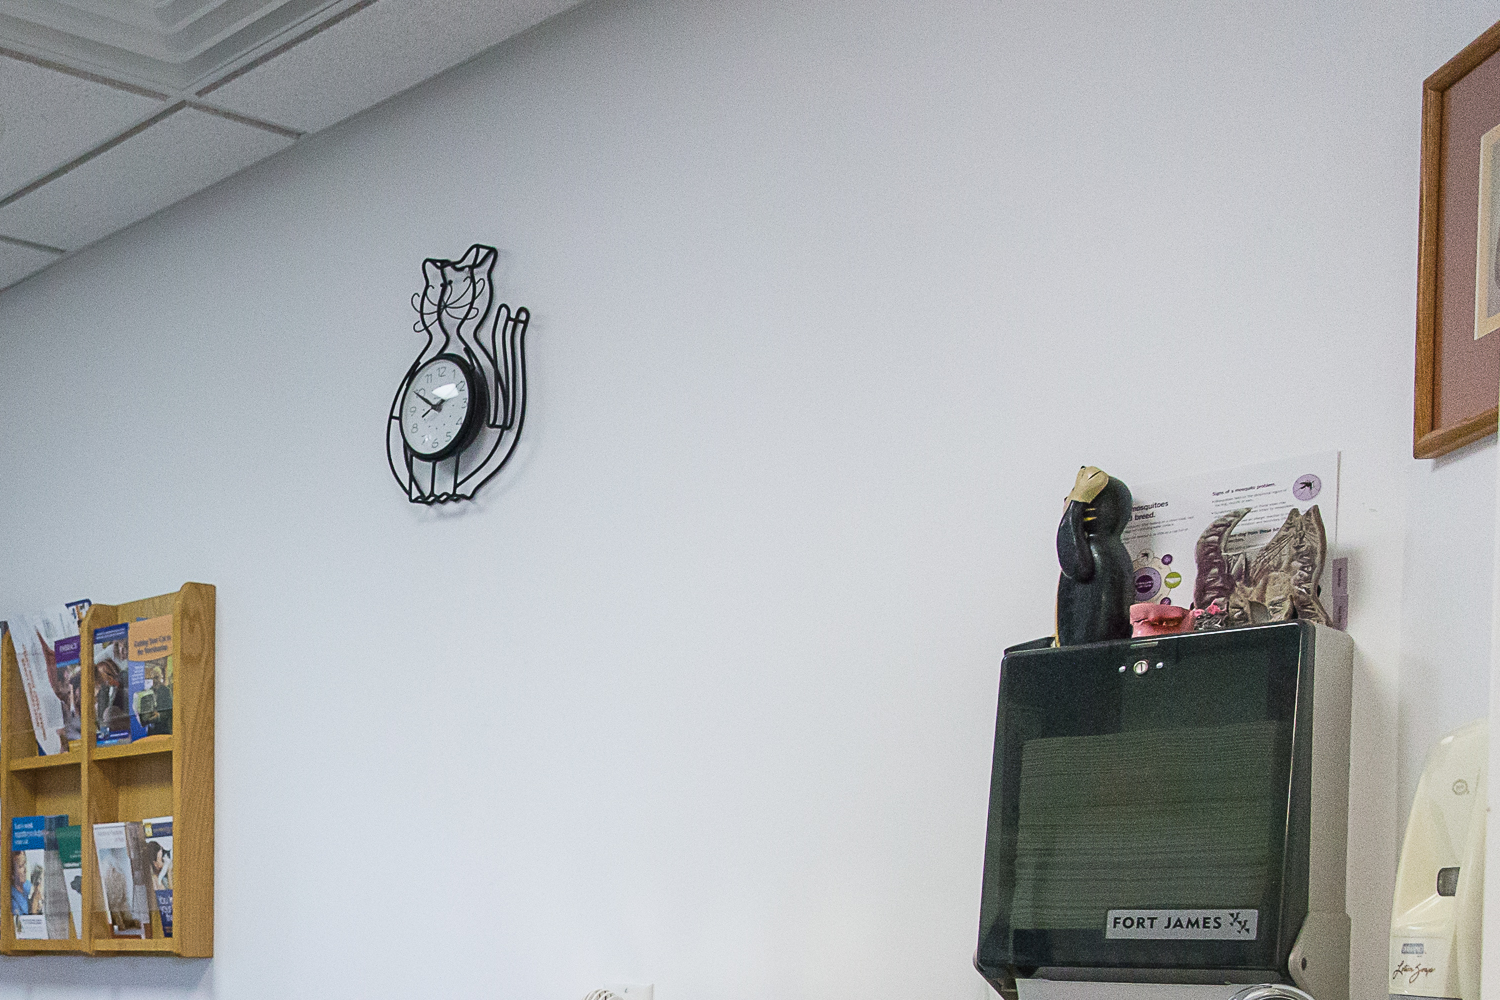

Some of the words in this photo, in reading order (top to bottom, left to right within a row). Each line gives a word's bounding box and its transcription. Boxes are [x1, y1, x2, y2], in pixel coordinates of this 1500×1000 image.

[436, 366, 446, 378] 12
[424, 374, 432, 384] 11
[456, 380, 465, 392] 2
[462, 398, 468, 408] 3
[410, 406, 416, 416] 9
[410, 423, 418, 434] 8
[445, 432, 452, 442] 5
[432, 438, 438, 448] 6
[1112, 916, 1158, 929] FORT
[1164, 916, 1222, 929] JAMES
